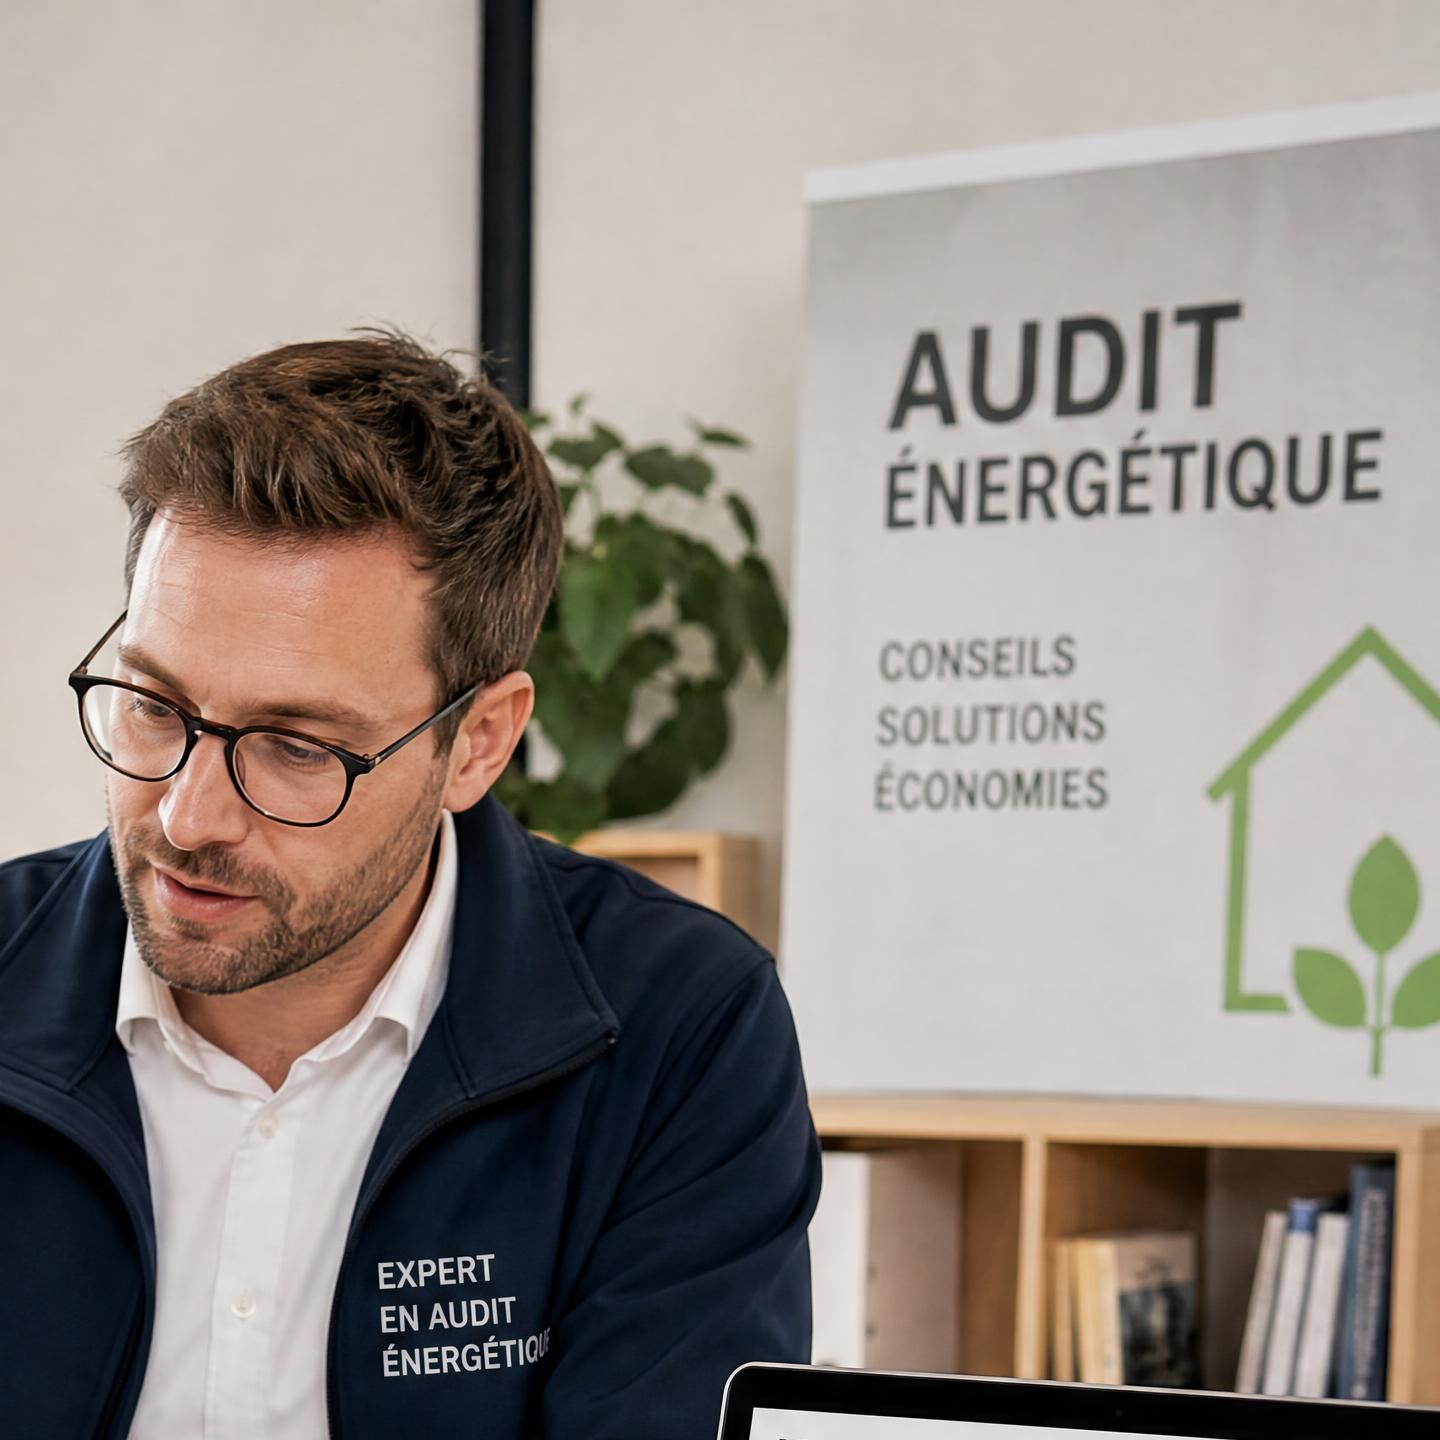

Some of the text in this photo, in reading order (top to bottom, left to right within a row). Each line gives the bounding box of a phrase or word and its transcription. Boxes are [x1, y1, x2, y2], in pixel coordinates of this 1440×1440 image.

[886, 301, 1244, 431] AUDIT
[884, 430, 1384, 530] ÉNERGÉTIQUE
[880, 636, 1078, 682] CONSEILS
[876, 701, 1106, 747] SOLUTIONS
[874, 763, 1109, 812] ÉCONOMIES
[378, 1254, 495, 1290] EXPERT
[380, 1296, 516, 1333] EN AUDIT
